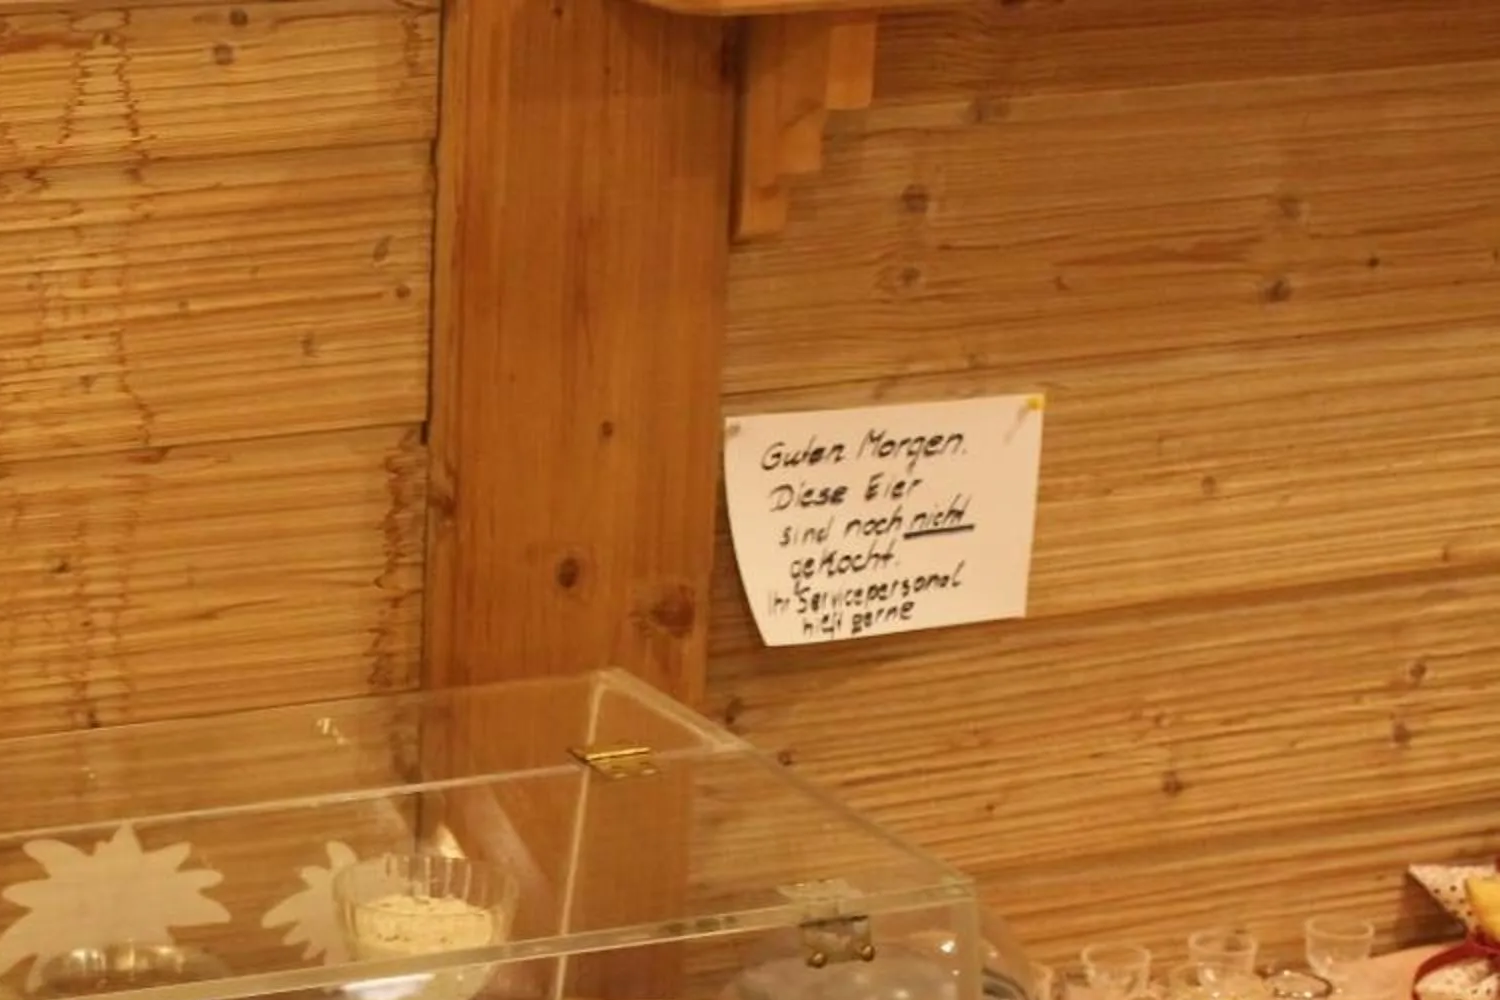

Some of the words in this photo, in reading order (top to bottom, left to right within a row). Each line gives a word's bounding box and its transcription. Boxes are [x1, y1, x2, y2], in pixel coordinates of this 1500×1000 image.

[760, 435, 846, 471] Guten
[770, 482, 849, 512] Diese
[863, 473, 923, 502] Eier
[778, 515, 835, 547] sind
[844, 506, 902, 539] noch
[851, 600, 916, 635] gerne
